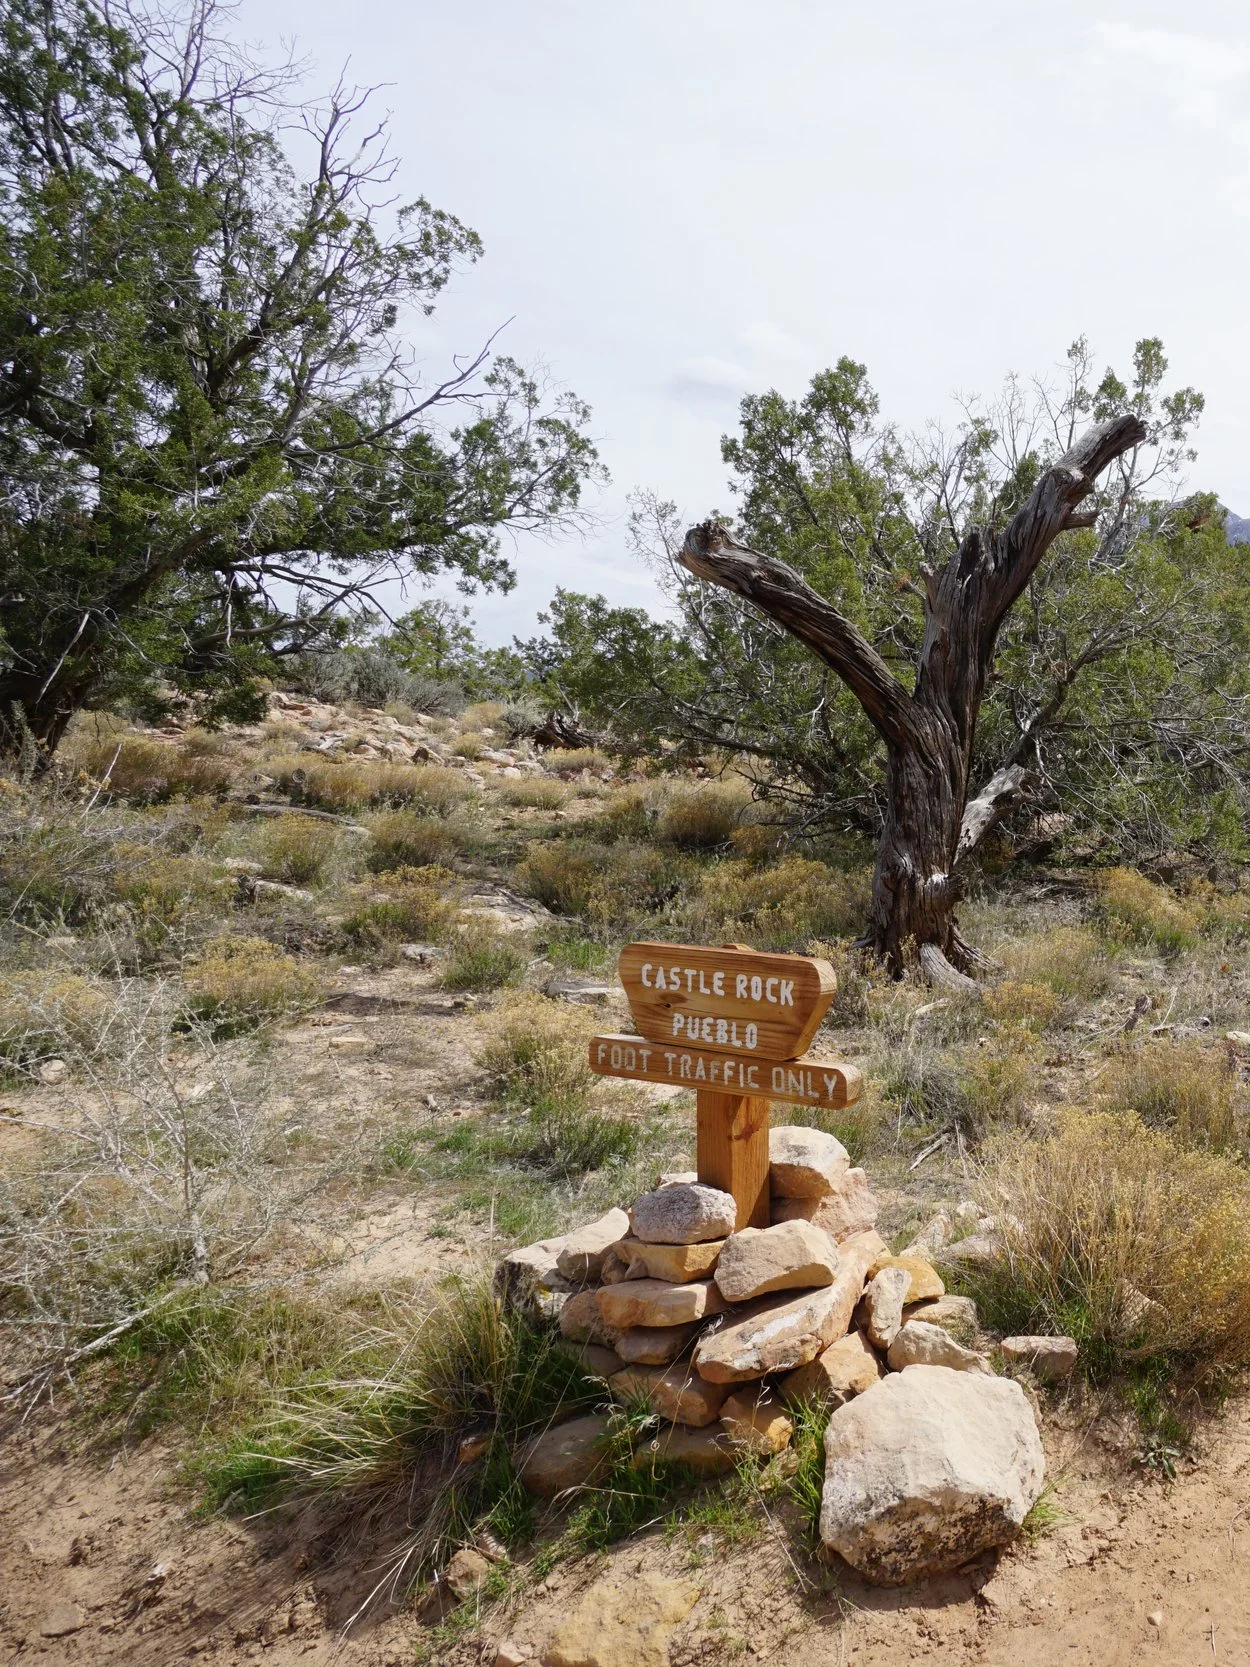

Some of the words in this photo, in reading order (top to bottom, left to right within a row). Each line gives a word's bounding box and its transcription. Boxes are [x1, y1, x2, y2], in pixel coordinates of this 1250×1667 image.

[641, 963, 725, 996] CASTLE
[735, 974, 794, 1006] ROCK
[672, 1013, 758, 1050] PUEBLO
[597, 1043, 652, 1073] FOOT
[664, 1052, 760, 1089] TRAFFIC
[771, 1066, 837, 1101] ONLY
